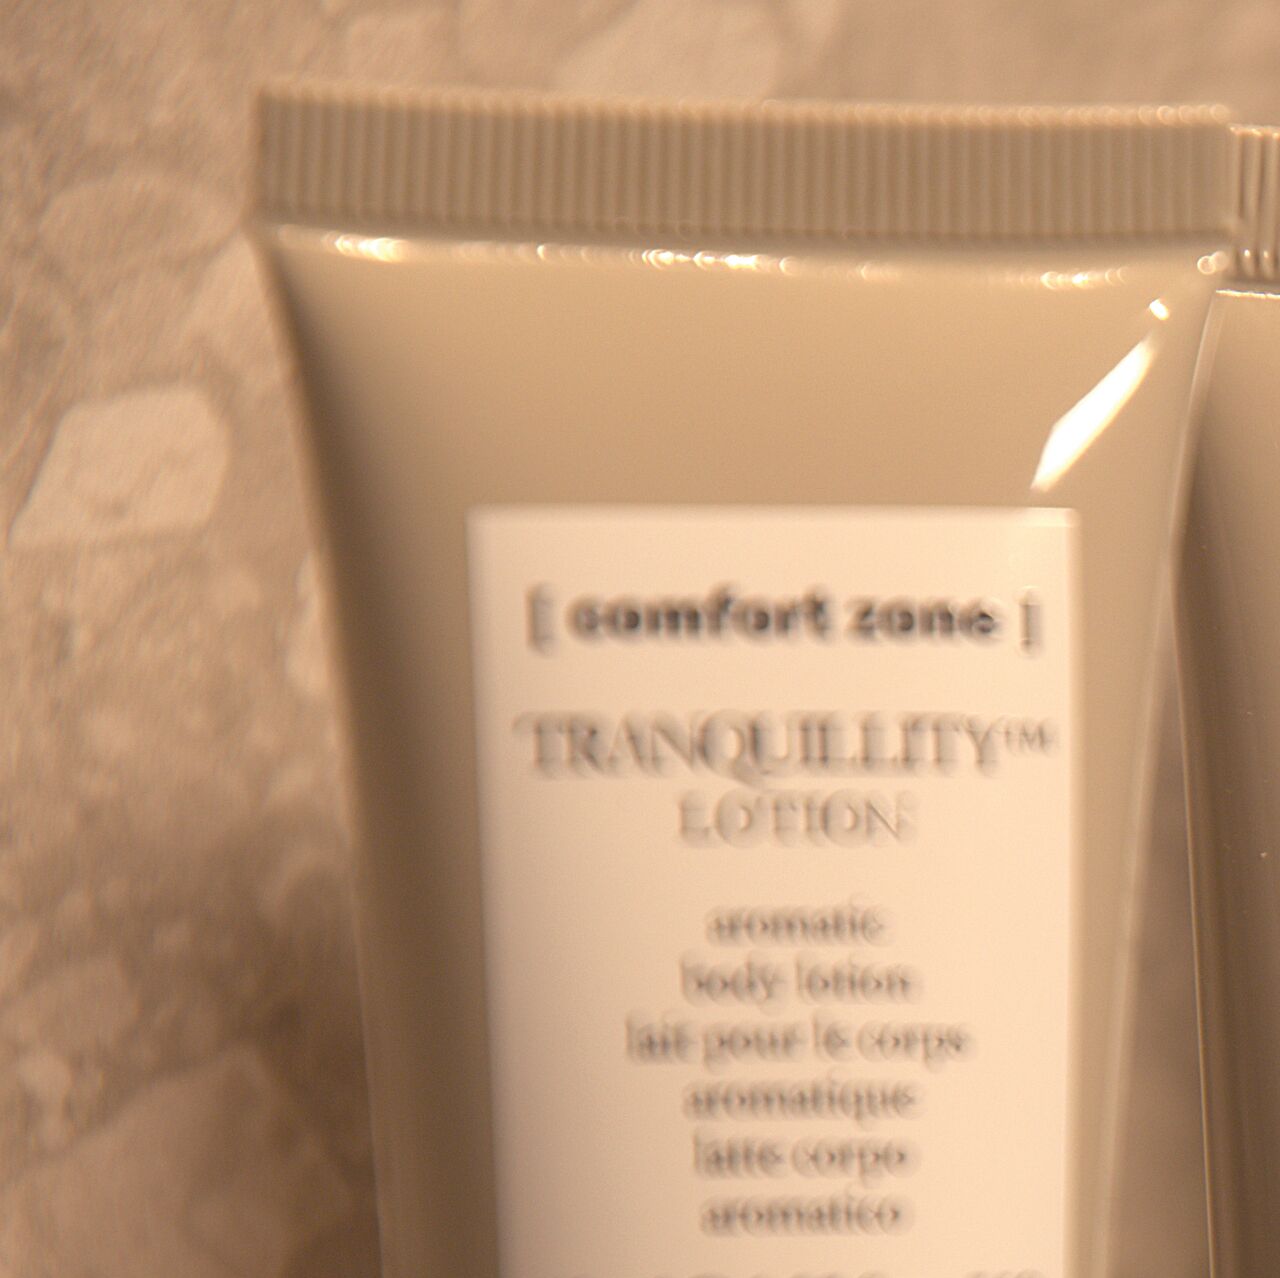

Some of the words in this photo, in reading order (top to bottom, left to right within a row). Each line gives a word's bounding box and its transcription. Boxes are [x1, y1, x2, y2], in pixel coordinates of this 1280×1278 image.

[567, 582, 831, 645] comfort
[844, 596, 1005, 645] zone
[676, 792, 916, 844] LOTION
[706, 902, 890, 946] aromatic
[680, 952, 786, 1012] body
[796, 954, 916, 1004] lotion
[625, 1014, 694, 1062] lait
[702, 1024, 800, 1072] pour
[811, 1012, 852, 1062] le
[857, 1024, 972, 1070] corps
[684, 1072, 918, 1128] aromatique
[694, 1130, 784, 1178] latte
[791, 1140, 910, 1186] corpo
[702, 1190, 908, 1236] aromatico
